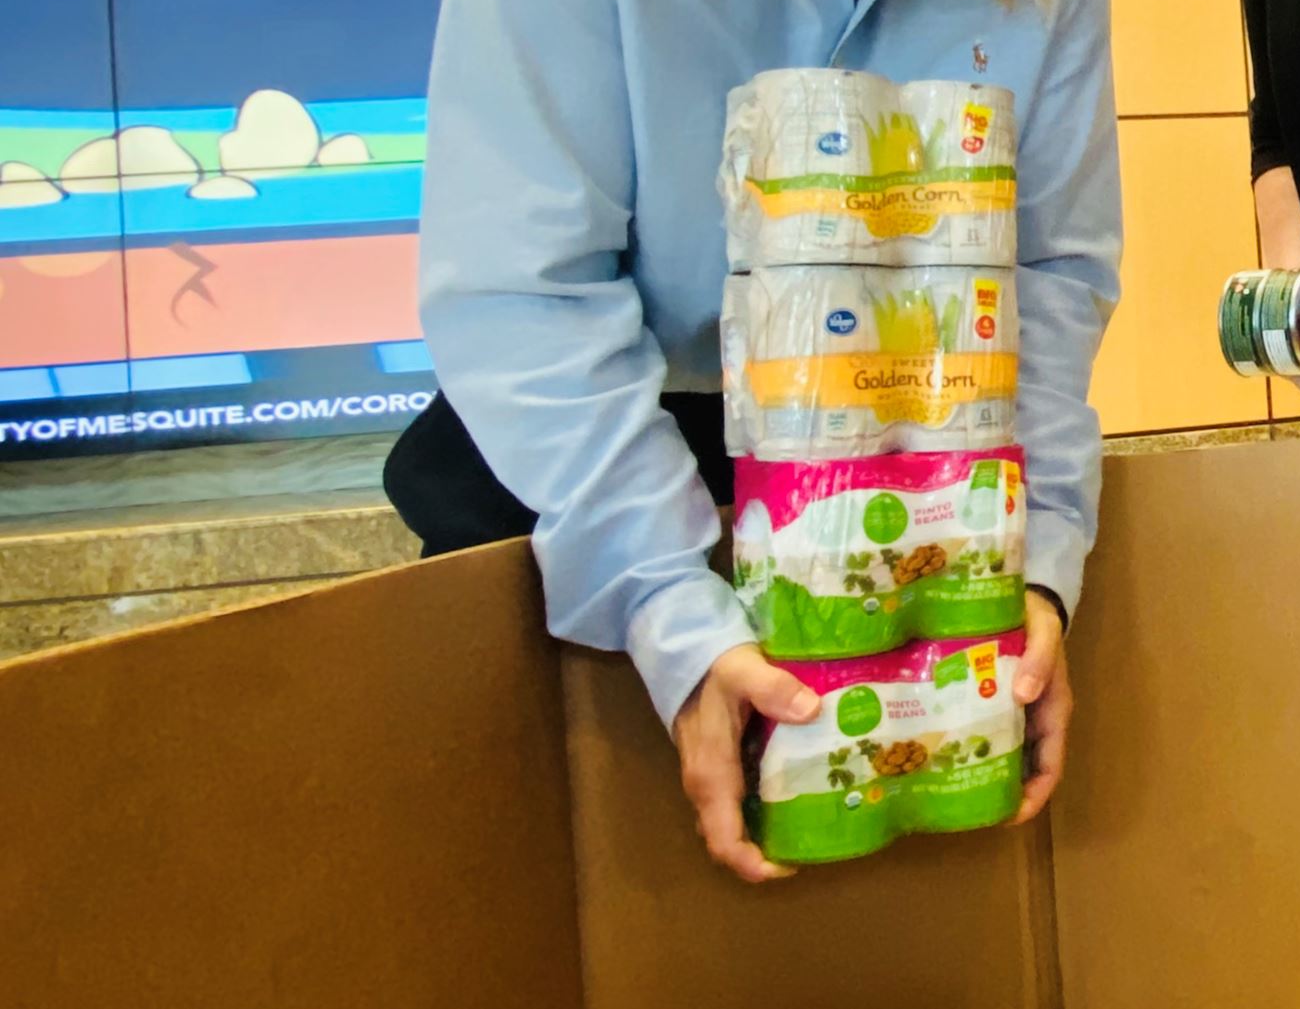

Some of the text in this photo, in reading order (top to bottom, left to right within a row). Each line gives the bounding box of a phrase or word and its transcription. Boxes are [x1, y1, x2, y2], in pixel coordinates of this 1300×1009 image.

[846, 192, 907, 211] Golden
[912, 186, 963, 204] Corn
[854, 370, 976, 390] Golden Corn
[0, 390, 437, 442] TYOFMESQUITE.COM/CORO
[914, 503, 952, 516] PINTO
[914, 512, 955, 526] BEANS
[886, 699, 921, 709] PINTO
[888, 708, 927, 720] BEANS
